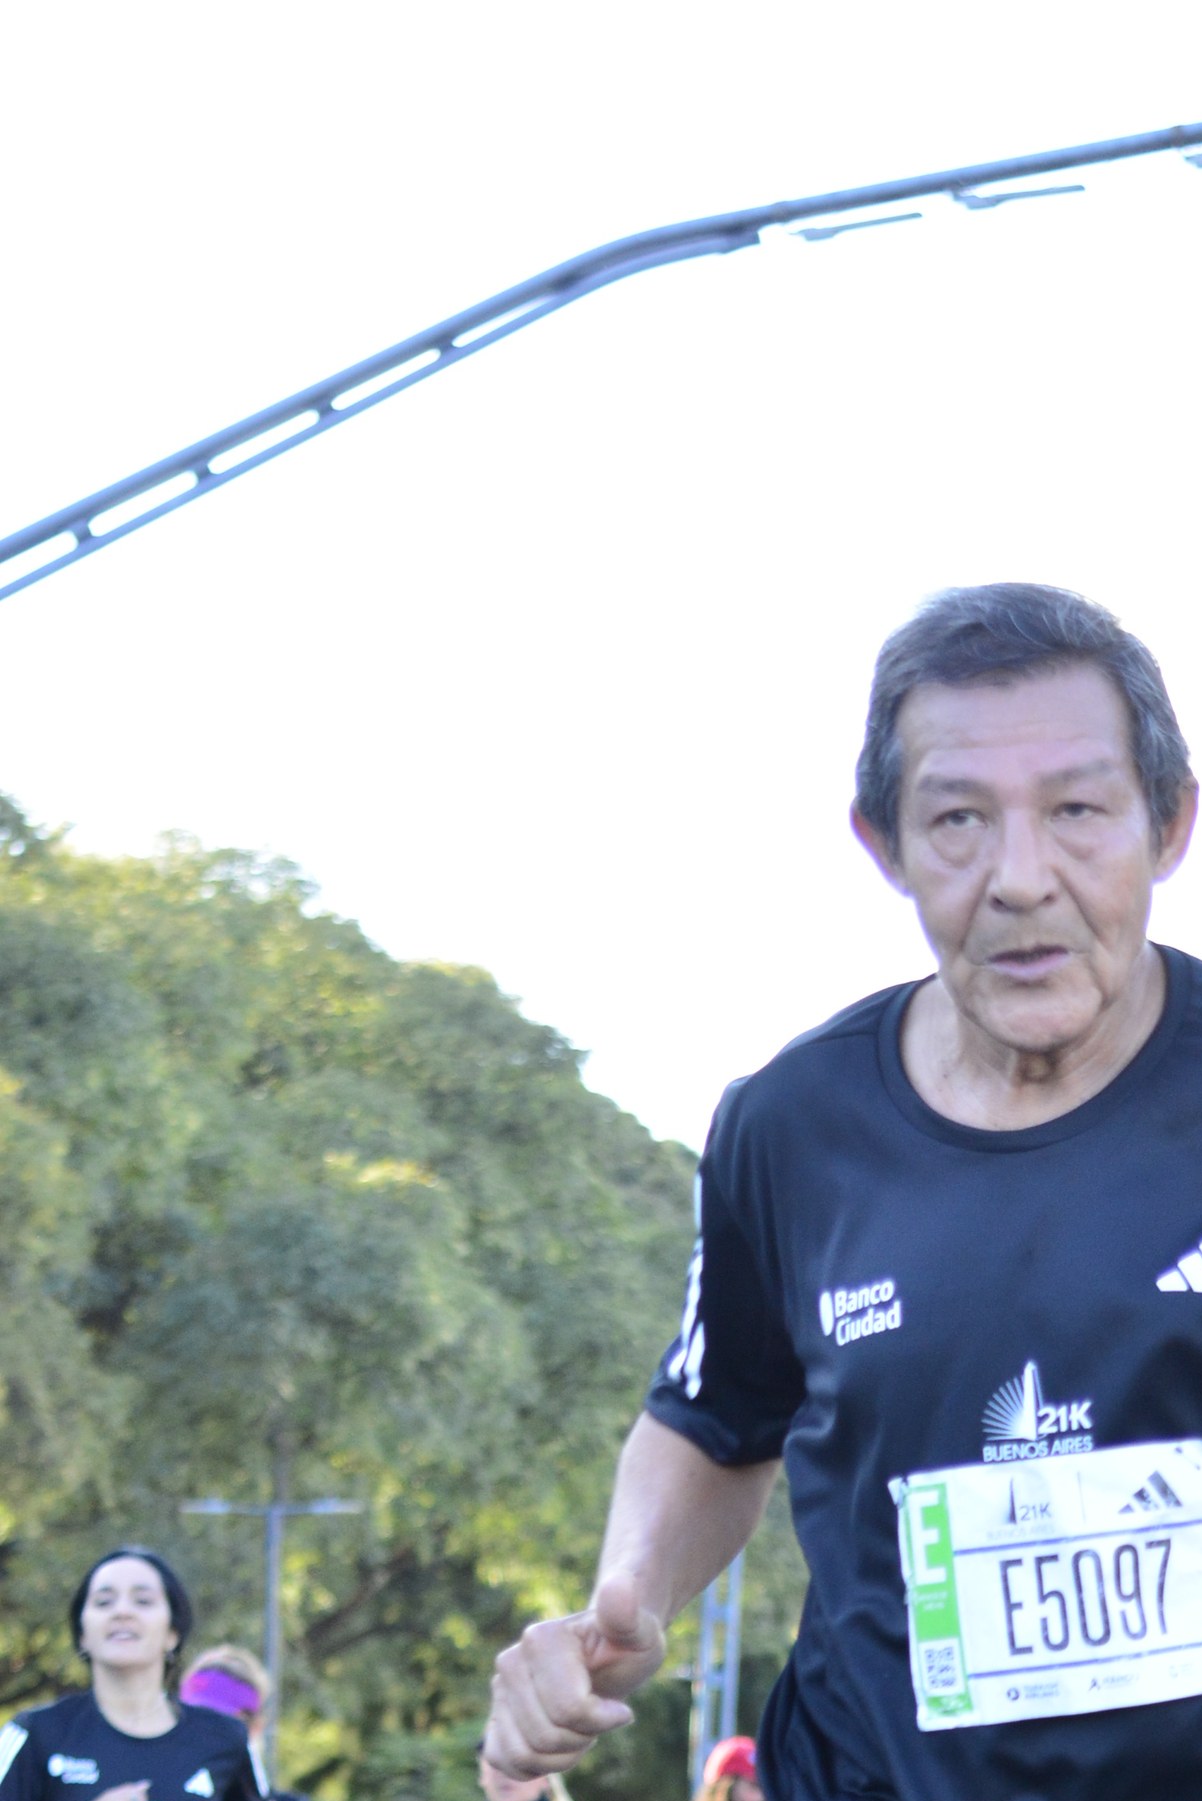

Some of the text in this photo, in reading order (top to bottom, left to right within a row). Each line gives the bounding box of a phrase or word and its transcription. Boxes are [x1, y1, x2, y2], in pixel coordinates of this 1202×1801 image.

[834, 1281, 894, 1317] Banco
[836, 1300, 901, 1346] Ciudad
[1037, 1401, 1093, 1434] 21K
[983, 1435, 1093, 1463] BUENOS AIRES
[1019, 1501, 1052, 1522] 21K
[907, 1488, 948, 1587] E
[998, 1538, 1171, 1656] E5097
